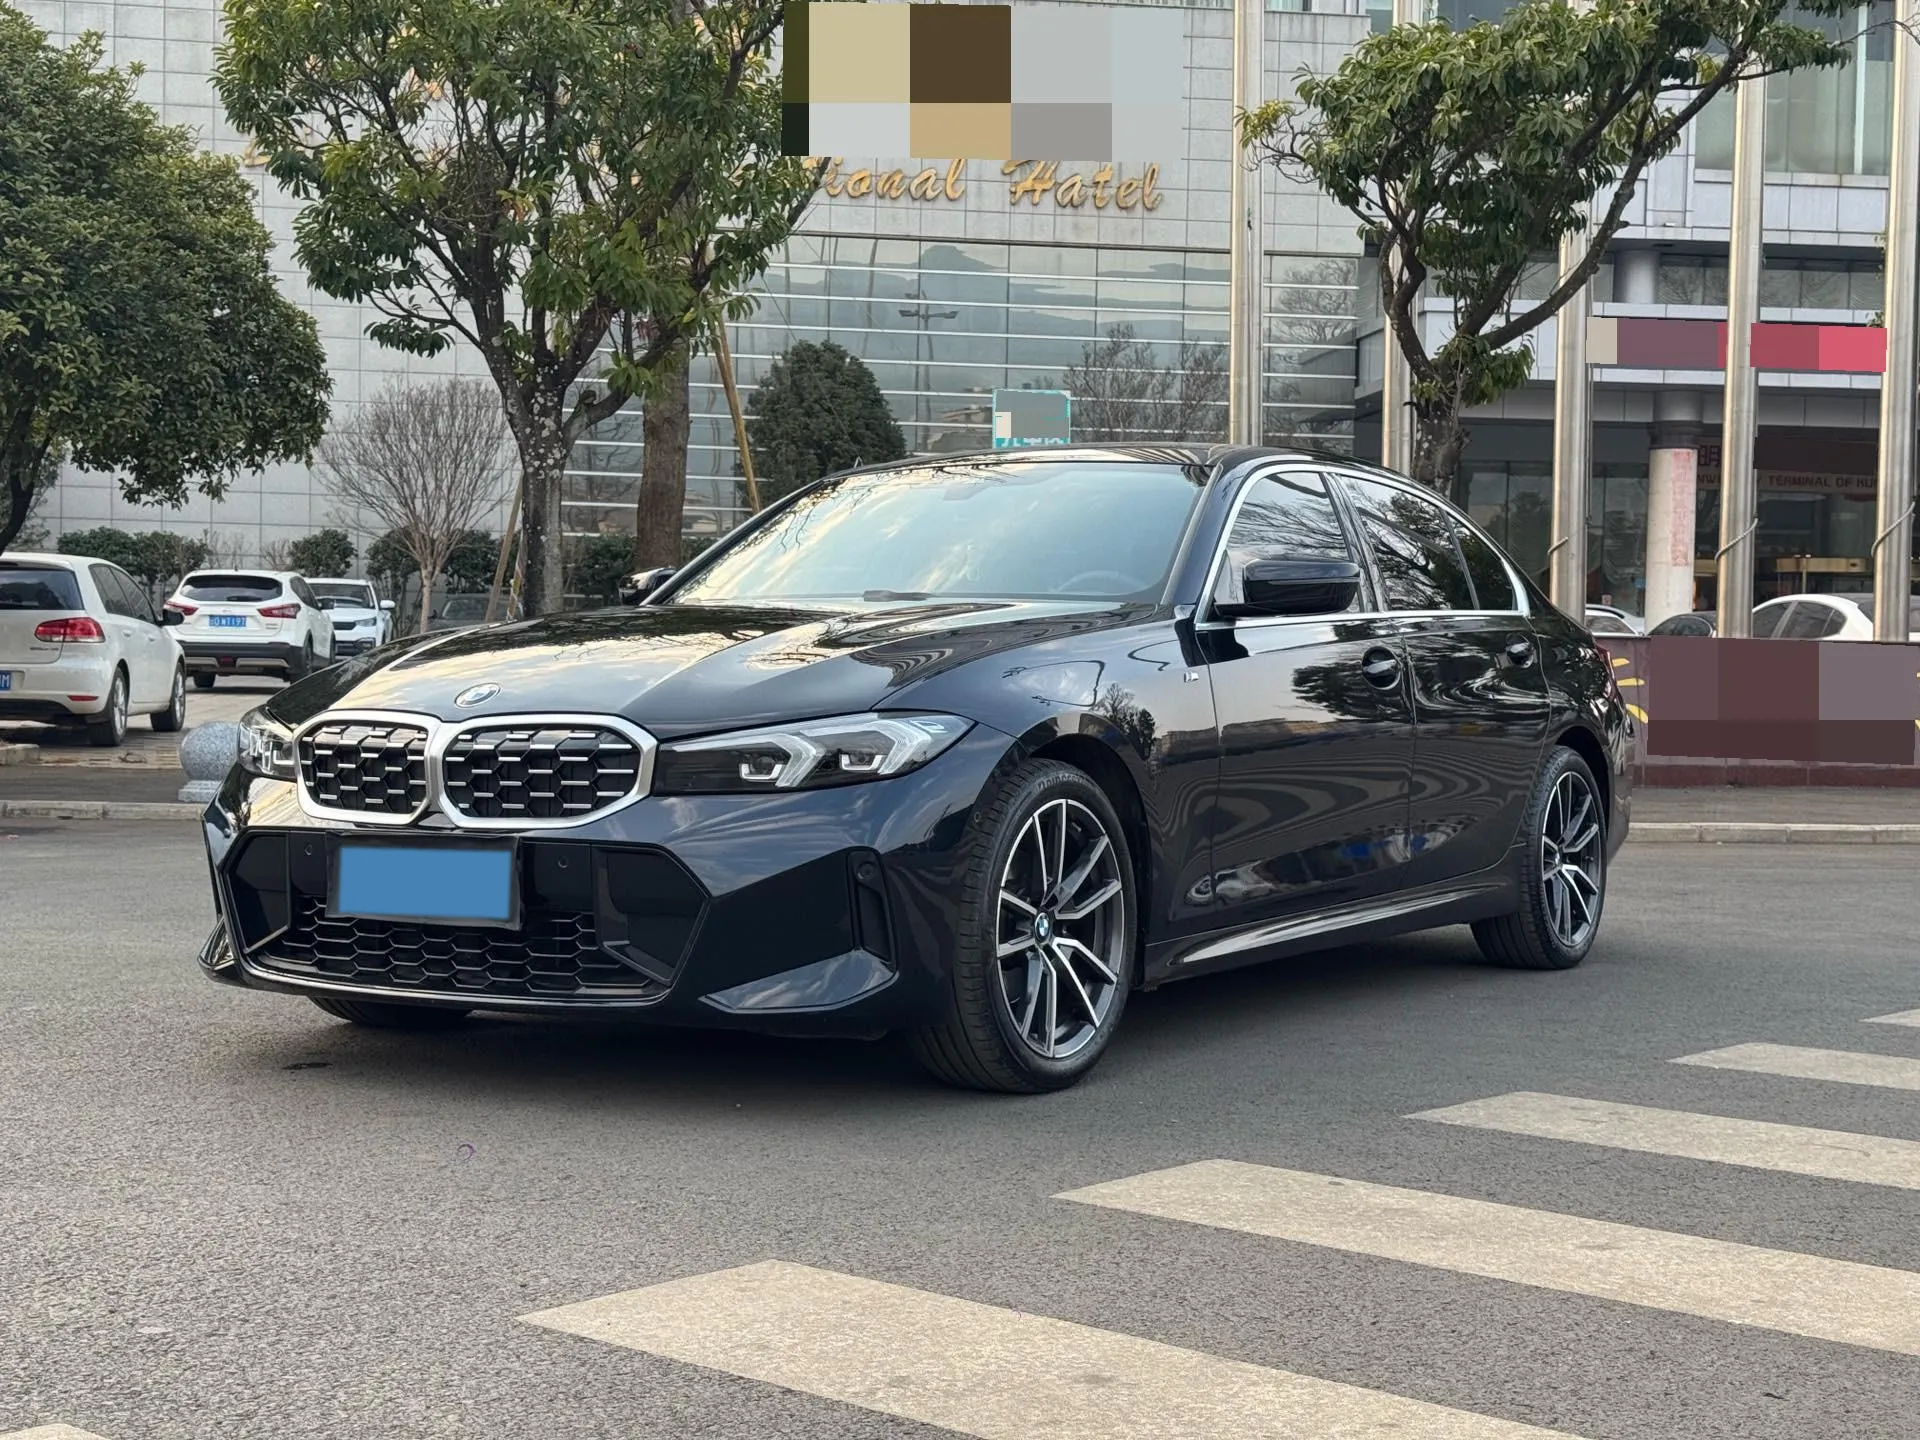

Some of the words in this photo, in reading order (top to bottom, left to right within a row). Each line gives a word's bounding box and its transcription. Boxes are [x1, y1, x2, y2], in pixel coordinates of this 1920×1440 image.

[802, 157, 967, 201] ional
[1768, 475, 1831, 488] TERMINAL
[1835, 477, 1854, 488] OF
